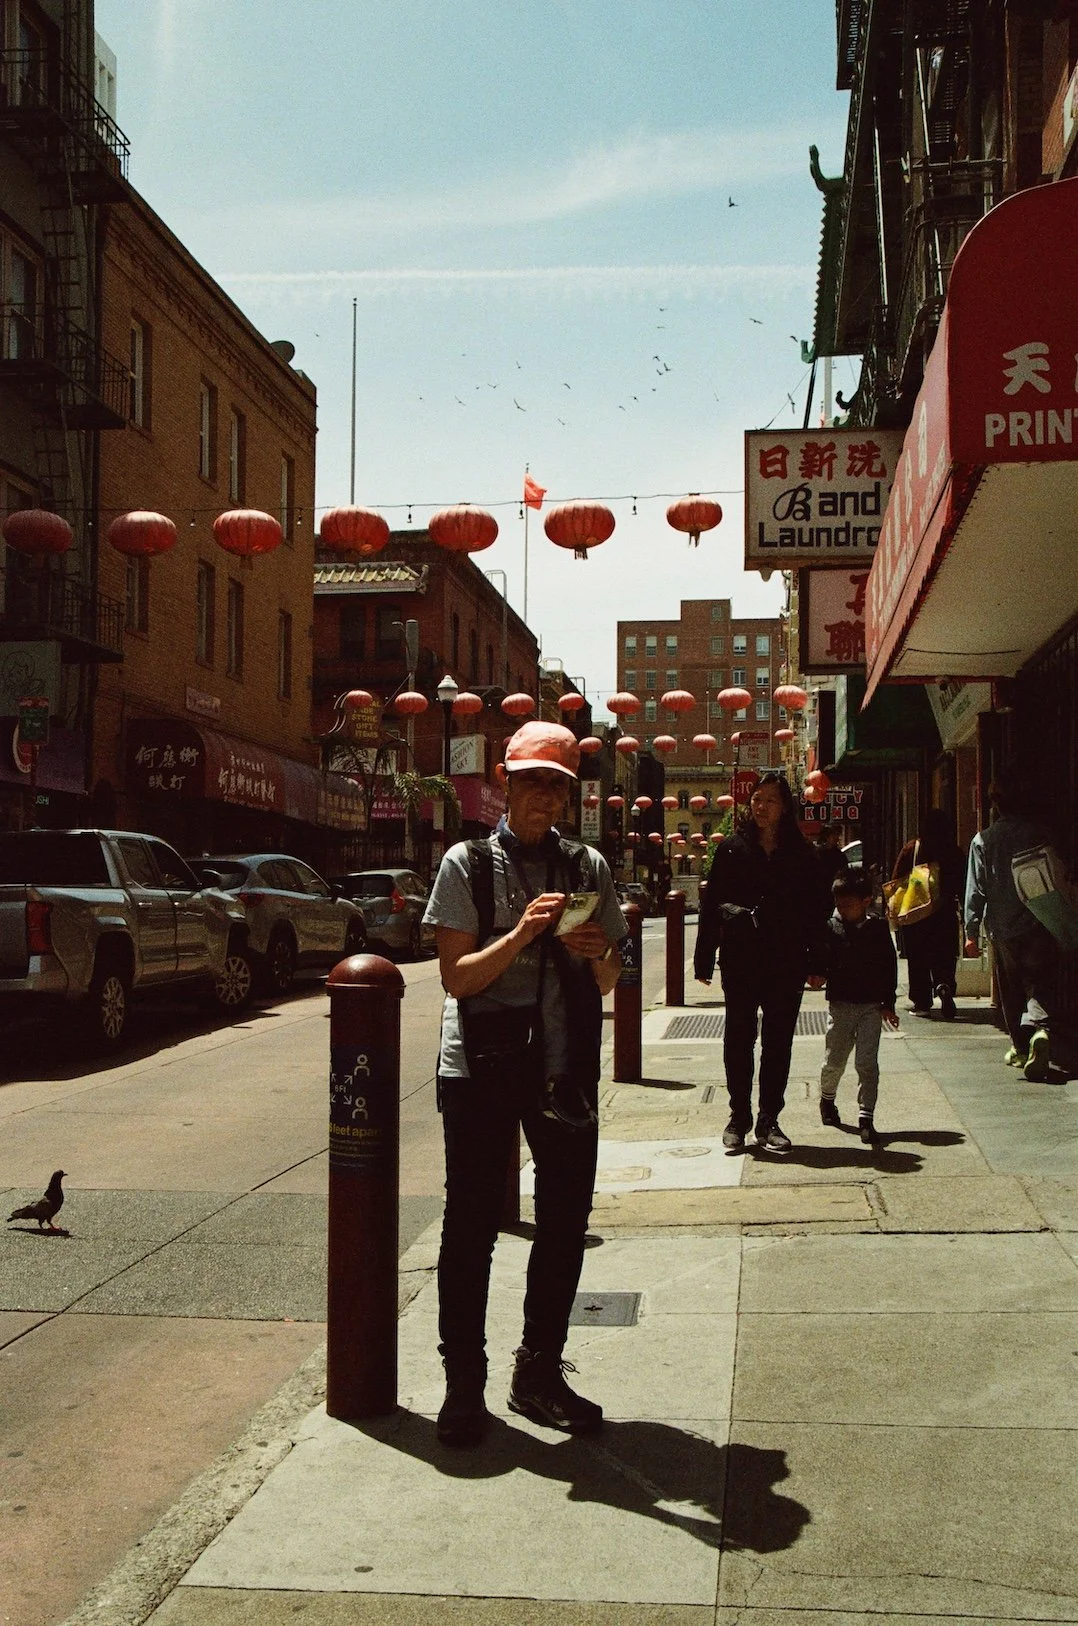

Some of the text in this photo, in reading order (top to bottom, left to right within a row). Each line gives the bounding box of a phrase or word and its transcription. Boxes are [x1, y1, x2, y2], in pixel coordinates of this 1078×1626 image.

[759, 440, 887, 480] 日新洗
[819, 481, 881, 516] and
